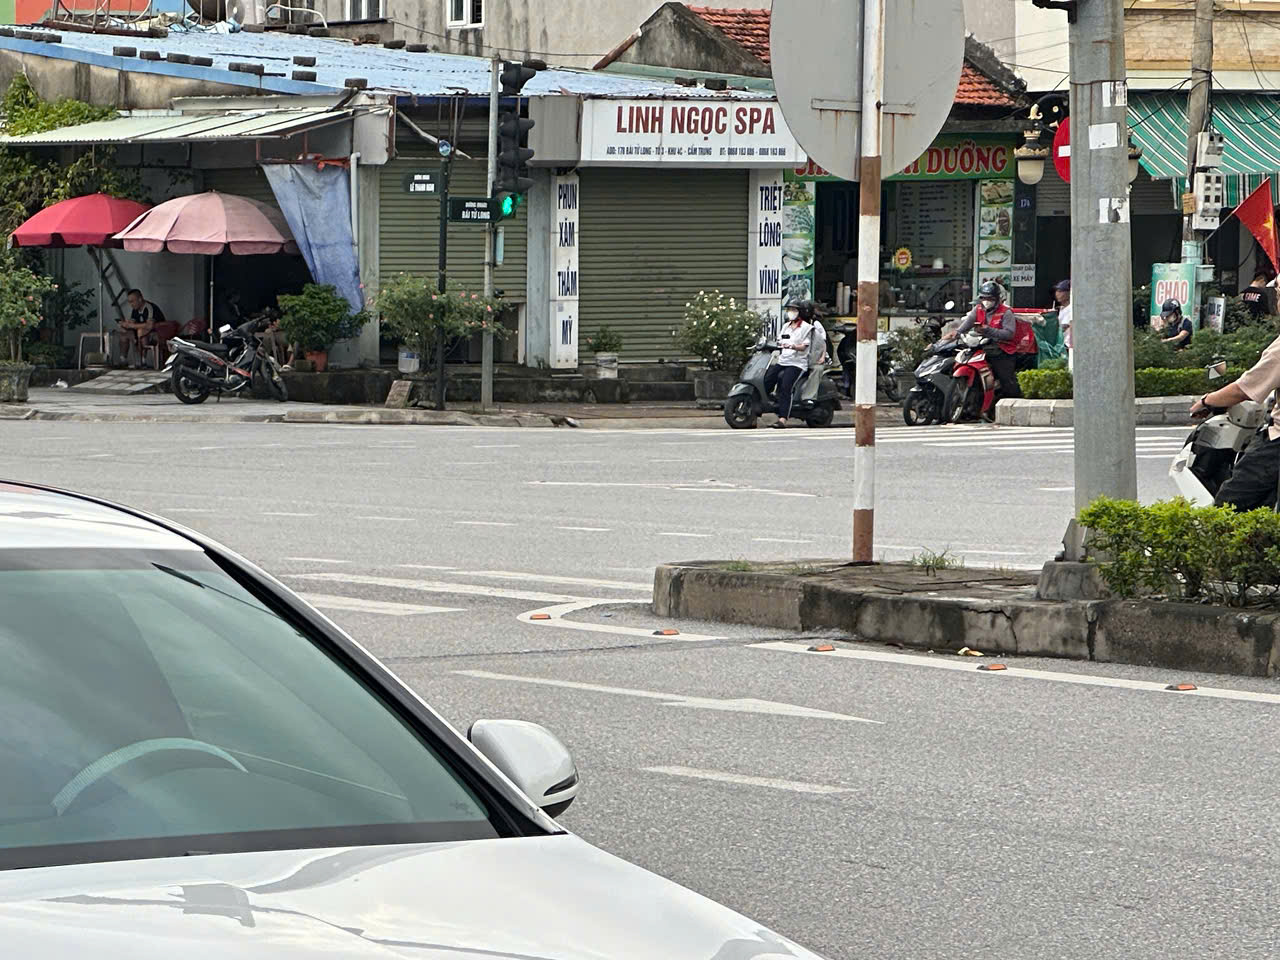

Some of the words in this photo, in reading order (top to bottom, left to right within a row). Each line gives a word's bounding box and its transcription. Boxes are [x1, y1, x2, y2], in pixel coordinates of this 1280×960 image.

[616, 106, 663, 133] LINH
[670, 106, 728, 141] NGỌC
[734, 107, 776, 135] SPA
[927, 139, 1008, 174] DƯỠNG
[558, 184, 577, 210] PHUN
[760, 181, 782, 214] TRIỆT
[759, 217, 781, 247] LÔNG
[1156, 275, 1189, 305] CHÁO
[561, 315, 573, 345] MỸ
